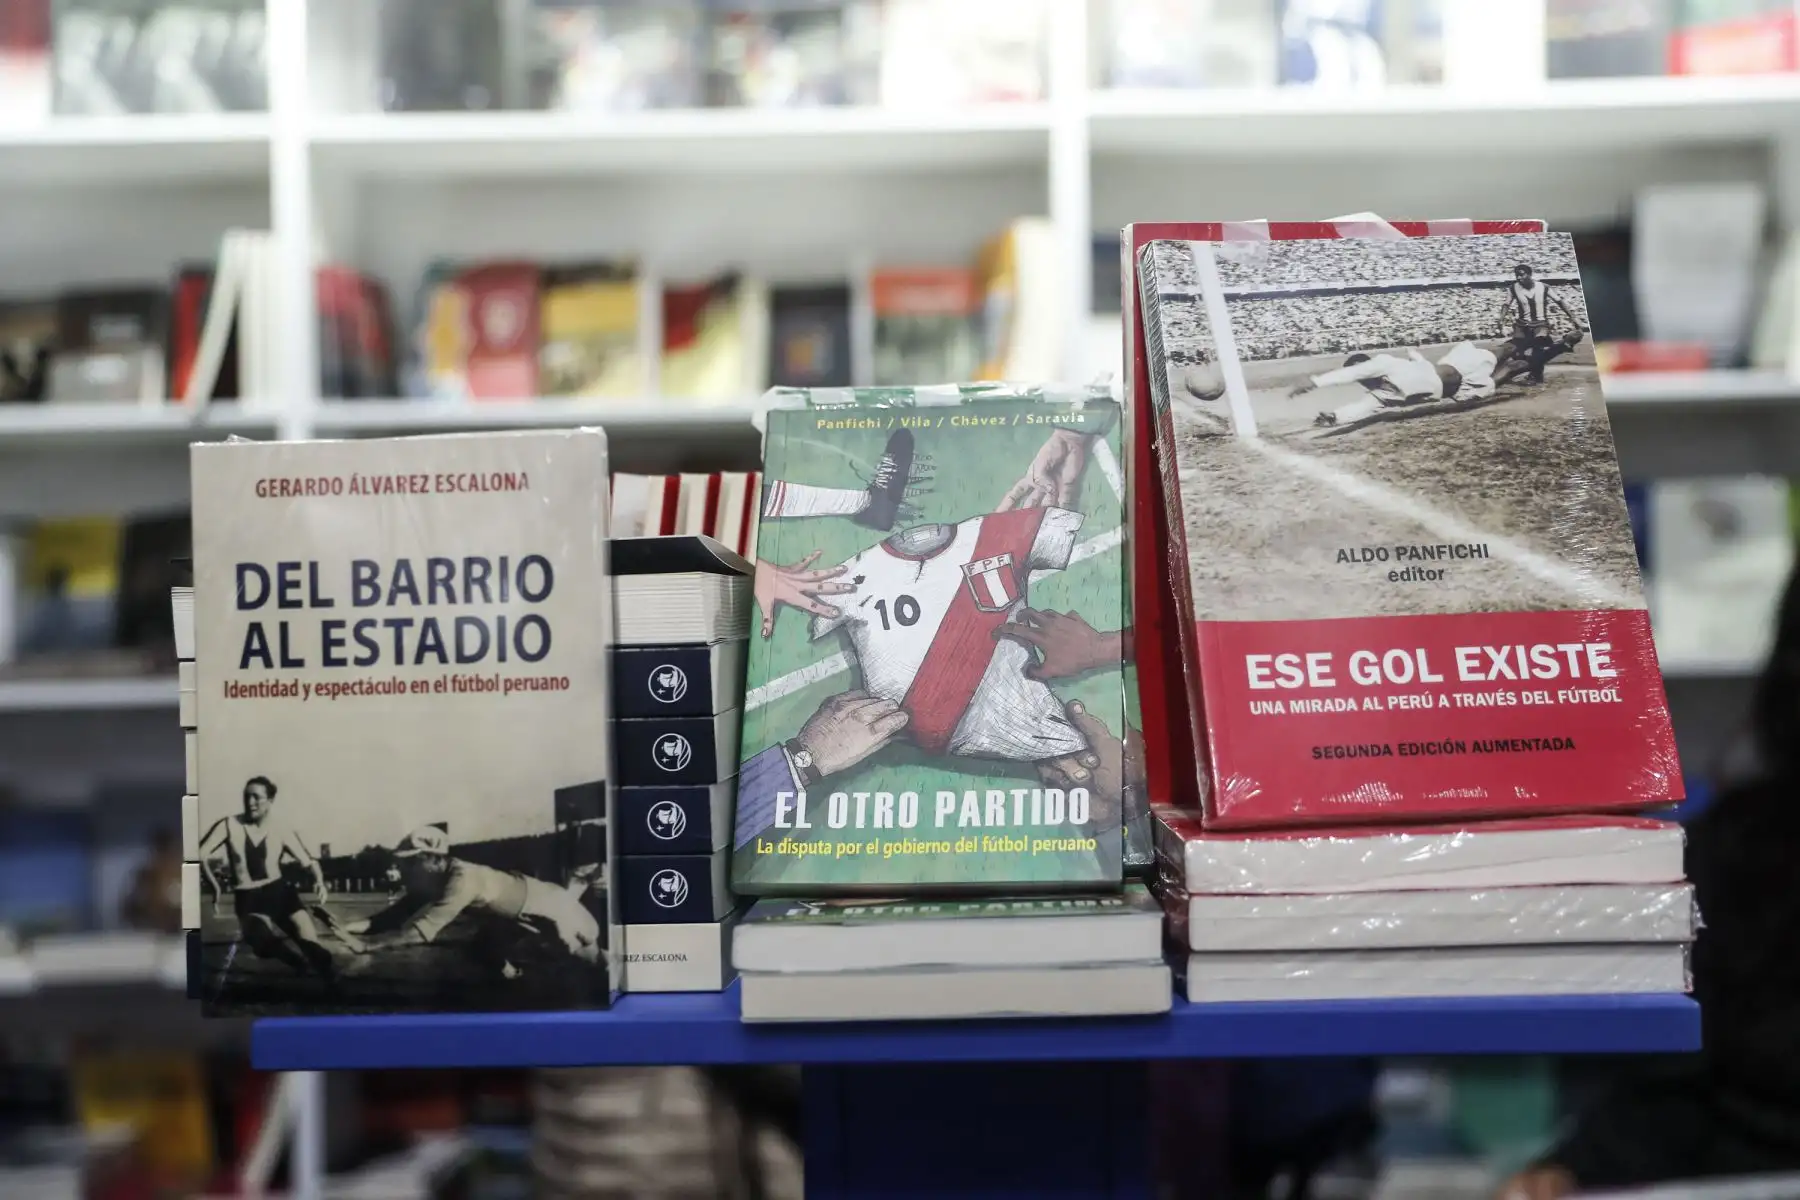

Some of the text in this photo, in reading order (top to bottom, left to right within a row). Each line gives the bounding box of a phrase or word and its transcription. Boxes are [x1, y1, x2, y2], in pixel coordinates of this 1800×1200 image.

[816, 416, 881, 430] Panfichi
[900, 415, 931, 428] Vila
[950, 414, 1007, 426] Chávez
[1025, 411, 1085, 424] Saravia
[255, 472, 530, 498] GERARDO ÁLVAREZ ESCALONA
[1336, 543, 1490, 564] ALDO PANFICHI
[235, 553, 555, 611] DEL BARRIO
[1387, 567, 1445, 583] editor
[874, 594, 921, 630] 10
[239, 613, 552, 669] AL ESTADIO
[1245, 642, 1618, 689] ESE GOL EXISTE
[224, 672, 570, 702] Identidad y espectáculo en el fútbol peruano
[1249, 685, 1623, 715] UNA MIRADA AL PERÚ A TRAVÉS DEL FÚTBOL
[1311, 736, 1576, 760] SEGUNDA EDICIÓN AUMENTADA
[774, 787, 1090, 829] EL OTRO PARTIDO
[756, 834, 1097, 860] La disputa por el gobierno del fútbol peruano
[642, 953, 689, 963] ESCALONA
